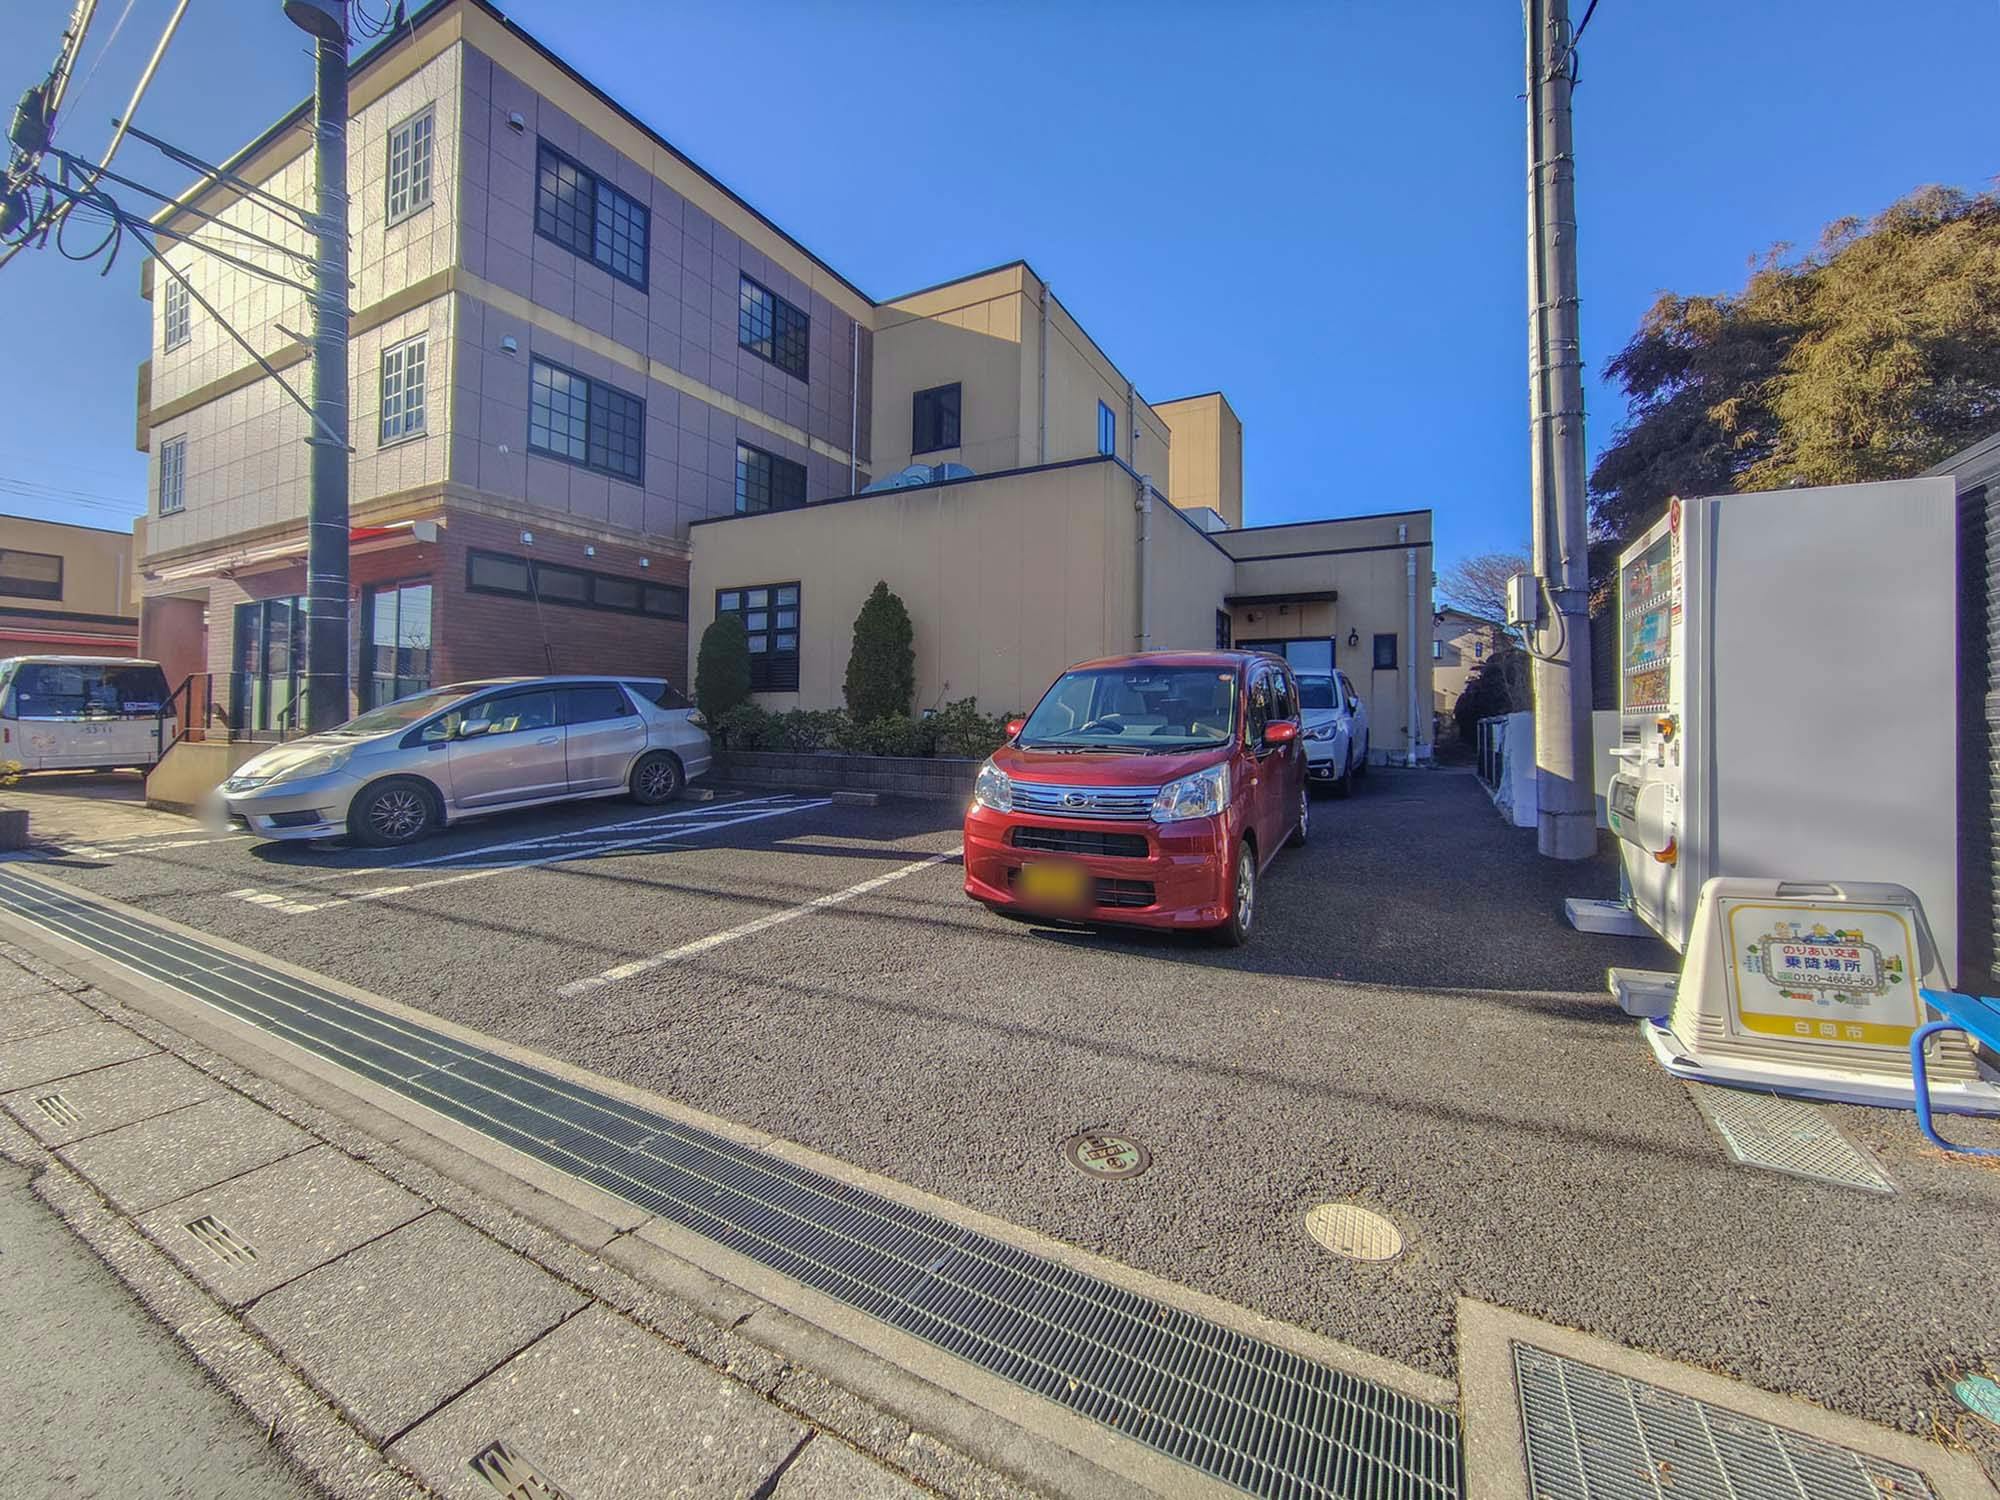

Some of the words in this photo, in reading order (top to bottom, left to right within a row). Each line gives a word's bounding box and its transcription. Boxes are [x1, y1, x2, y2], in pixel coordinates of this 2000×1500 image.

[1783, 945, 1861, 959] のりあい交通
[1785, 956, 1861, 973] 乗降場所
[1794, 973, 1874, 986] 0120-4605-50
[1795, 1022, 1864, 1040] 白岡市
